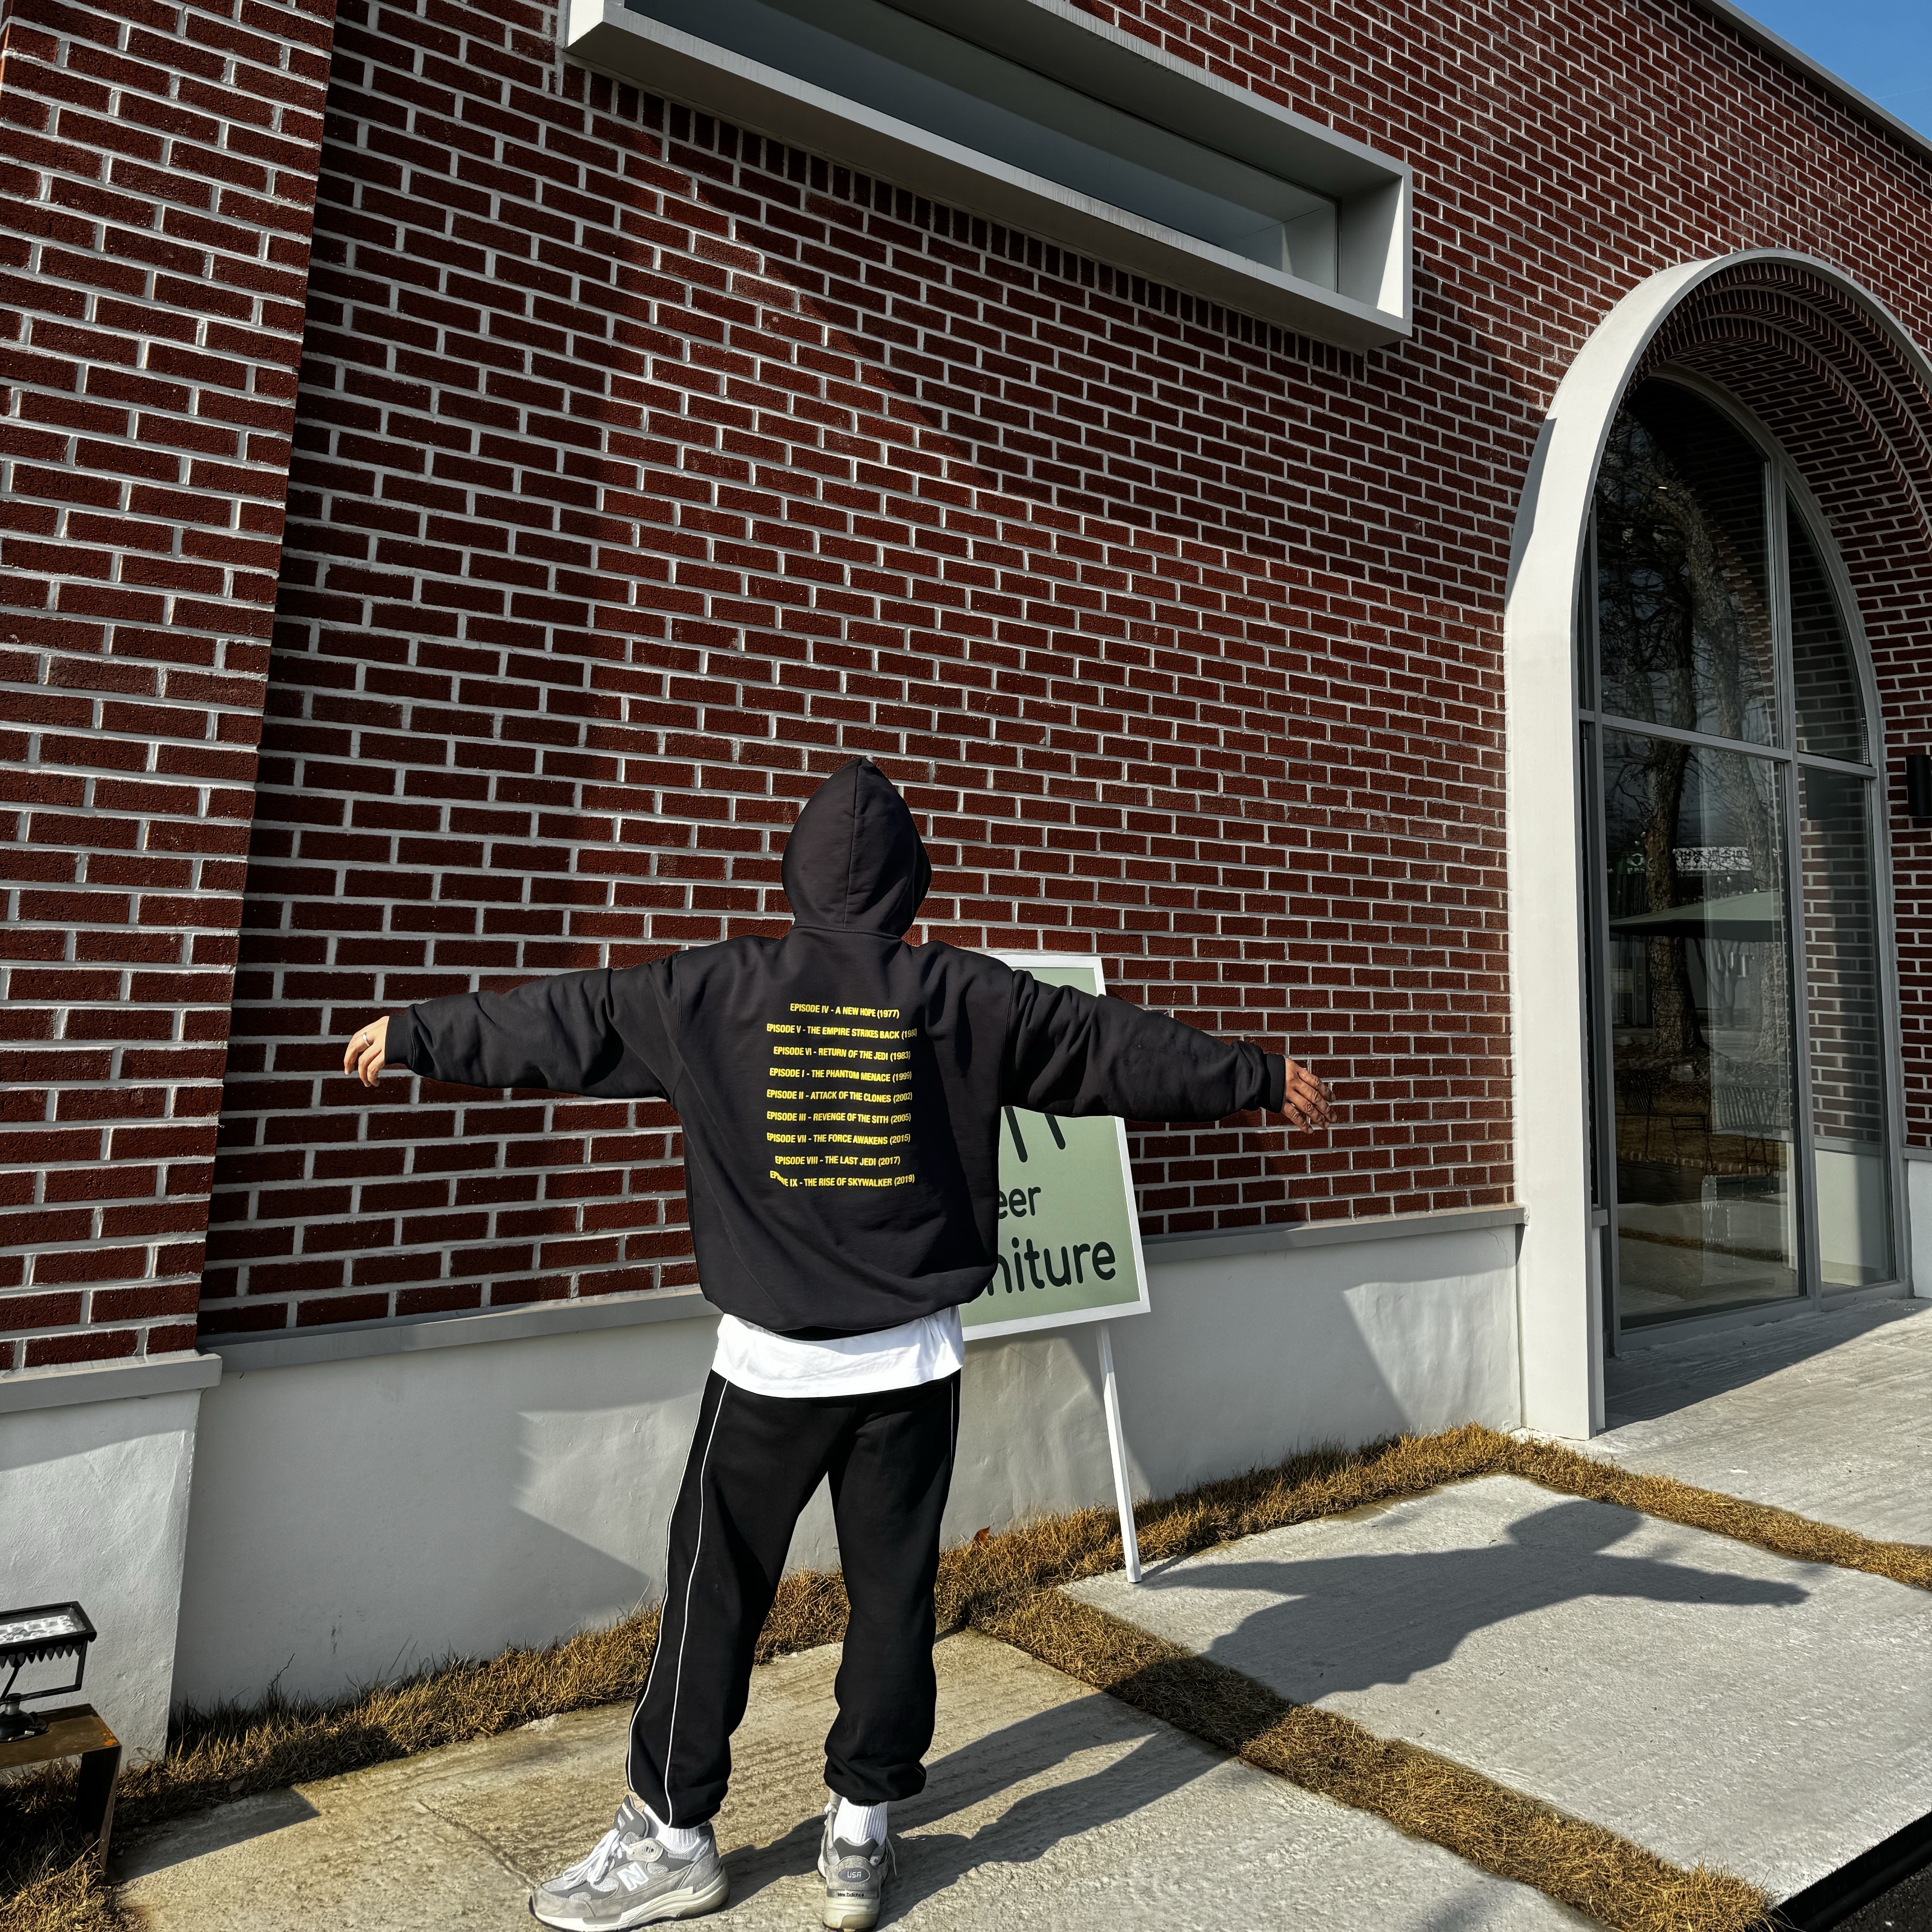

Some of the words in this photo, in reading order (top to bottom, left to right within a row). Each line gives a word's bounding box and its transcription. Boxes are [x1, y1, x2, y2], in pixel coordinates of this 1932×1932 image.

[790, 1003, 821, 1013] EPISODE
[821, 1005, 830, 1014] IV
[835, 1006, 841, 1015] A
[842, 1006, 859, 1016] NEW
[860, 1007, 876, 1017] HOPE
[876, 1009, 900, 1019] (1977)
[766, 1023, 796, 1033] EPISODE
[796, 1025, 802, 1033] V
[807, 1026, 821, 1035] THE
[822, 1026, 851, 1036] EMPIRE
[851, 1028, 879, 1039] STRIKES
[879, 1030, 900, 1040] BACK
[773, 1046, 805, 1056] EPISODE
[805, 1047, 812, 1056] VI
[818, 1048, 847, 1058] RETURN
[848, 1049, 859, 1058] OF
[859, 1050, 873, 1060] THE
[873, 1051, 889, 1061] JEDI
[890, 1051, 911, 1062] (1983)
[769, 1067, 801, 1077] EPISODE
[802, 1069, 805, 1078] I
[811, 1069, 825, 1078] THE
[825, 1069, 860, 1080] PHANTOM
[860, 1072, 891, 1082] MENACE
[892, 1071, 912, 1083] (1999)
[766, 1089, 798, 1099] EPISODE
[798, 1091, 804, 1099] II
[810, 1091, 838, 1100] ATTACK
[838, 1091, 849, 1099] OF
[849, 1091, 863, 1101] THE
[863, 1093, 892, 1103] CLONES
[893, 1091, 913, 1104] (2002)
[766, 1111, 798, 1121] EPISODE
[798, 1113, 807, 1121] III
[813, 1112, 846, 1121] REVENGE
[847, 1113, 857, 1122] OF
[857, 1113, 871, 1123] THE
[871, 1115, 889, 1124] SITH
[890, 1113, 911, 1125] (2005)
[766, 1132, 796, 1143] EPISODE
[797, 1134, 807, 1143] VII
[813, 1134, 827, 1143] THE
[828, 1134, 853, 1143] FORCE
[852, 1135, 888, 1145] AWAKENS
[890, 1133, 911, 1145] (2015)
[775, 1155, 806, 1165] EPISODE
[806, 1156, 818, 1164] VIII
[824, 1155, 839, 1164] THE
[839, 1156, 859, 1165] LAST
[859, 1157, 876, 1166] JEDI
[878, 1156, 900, 1167] (2017)
[789, 1178, 798, 1187] IX
[803, 1178, 817, 1187] THE
[818, 1178, 835, 1187] RISE
[836, 1177, 847, 1186] OF
[847, 1178, 892, 1187] SKYWALKER
[894, 1173, 915, 1187] (2019)
[987, 1237, 1116, 1296] niture
[617, 1862, 650, 1892] N
